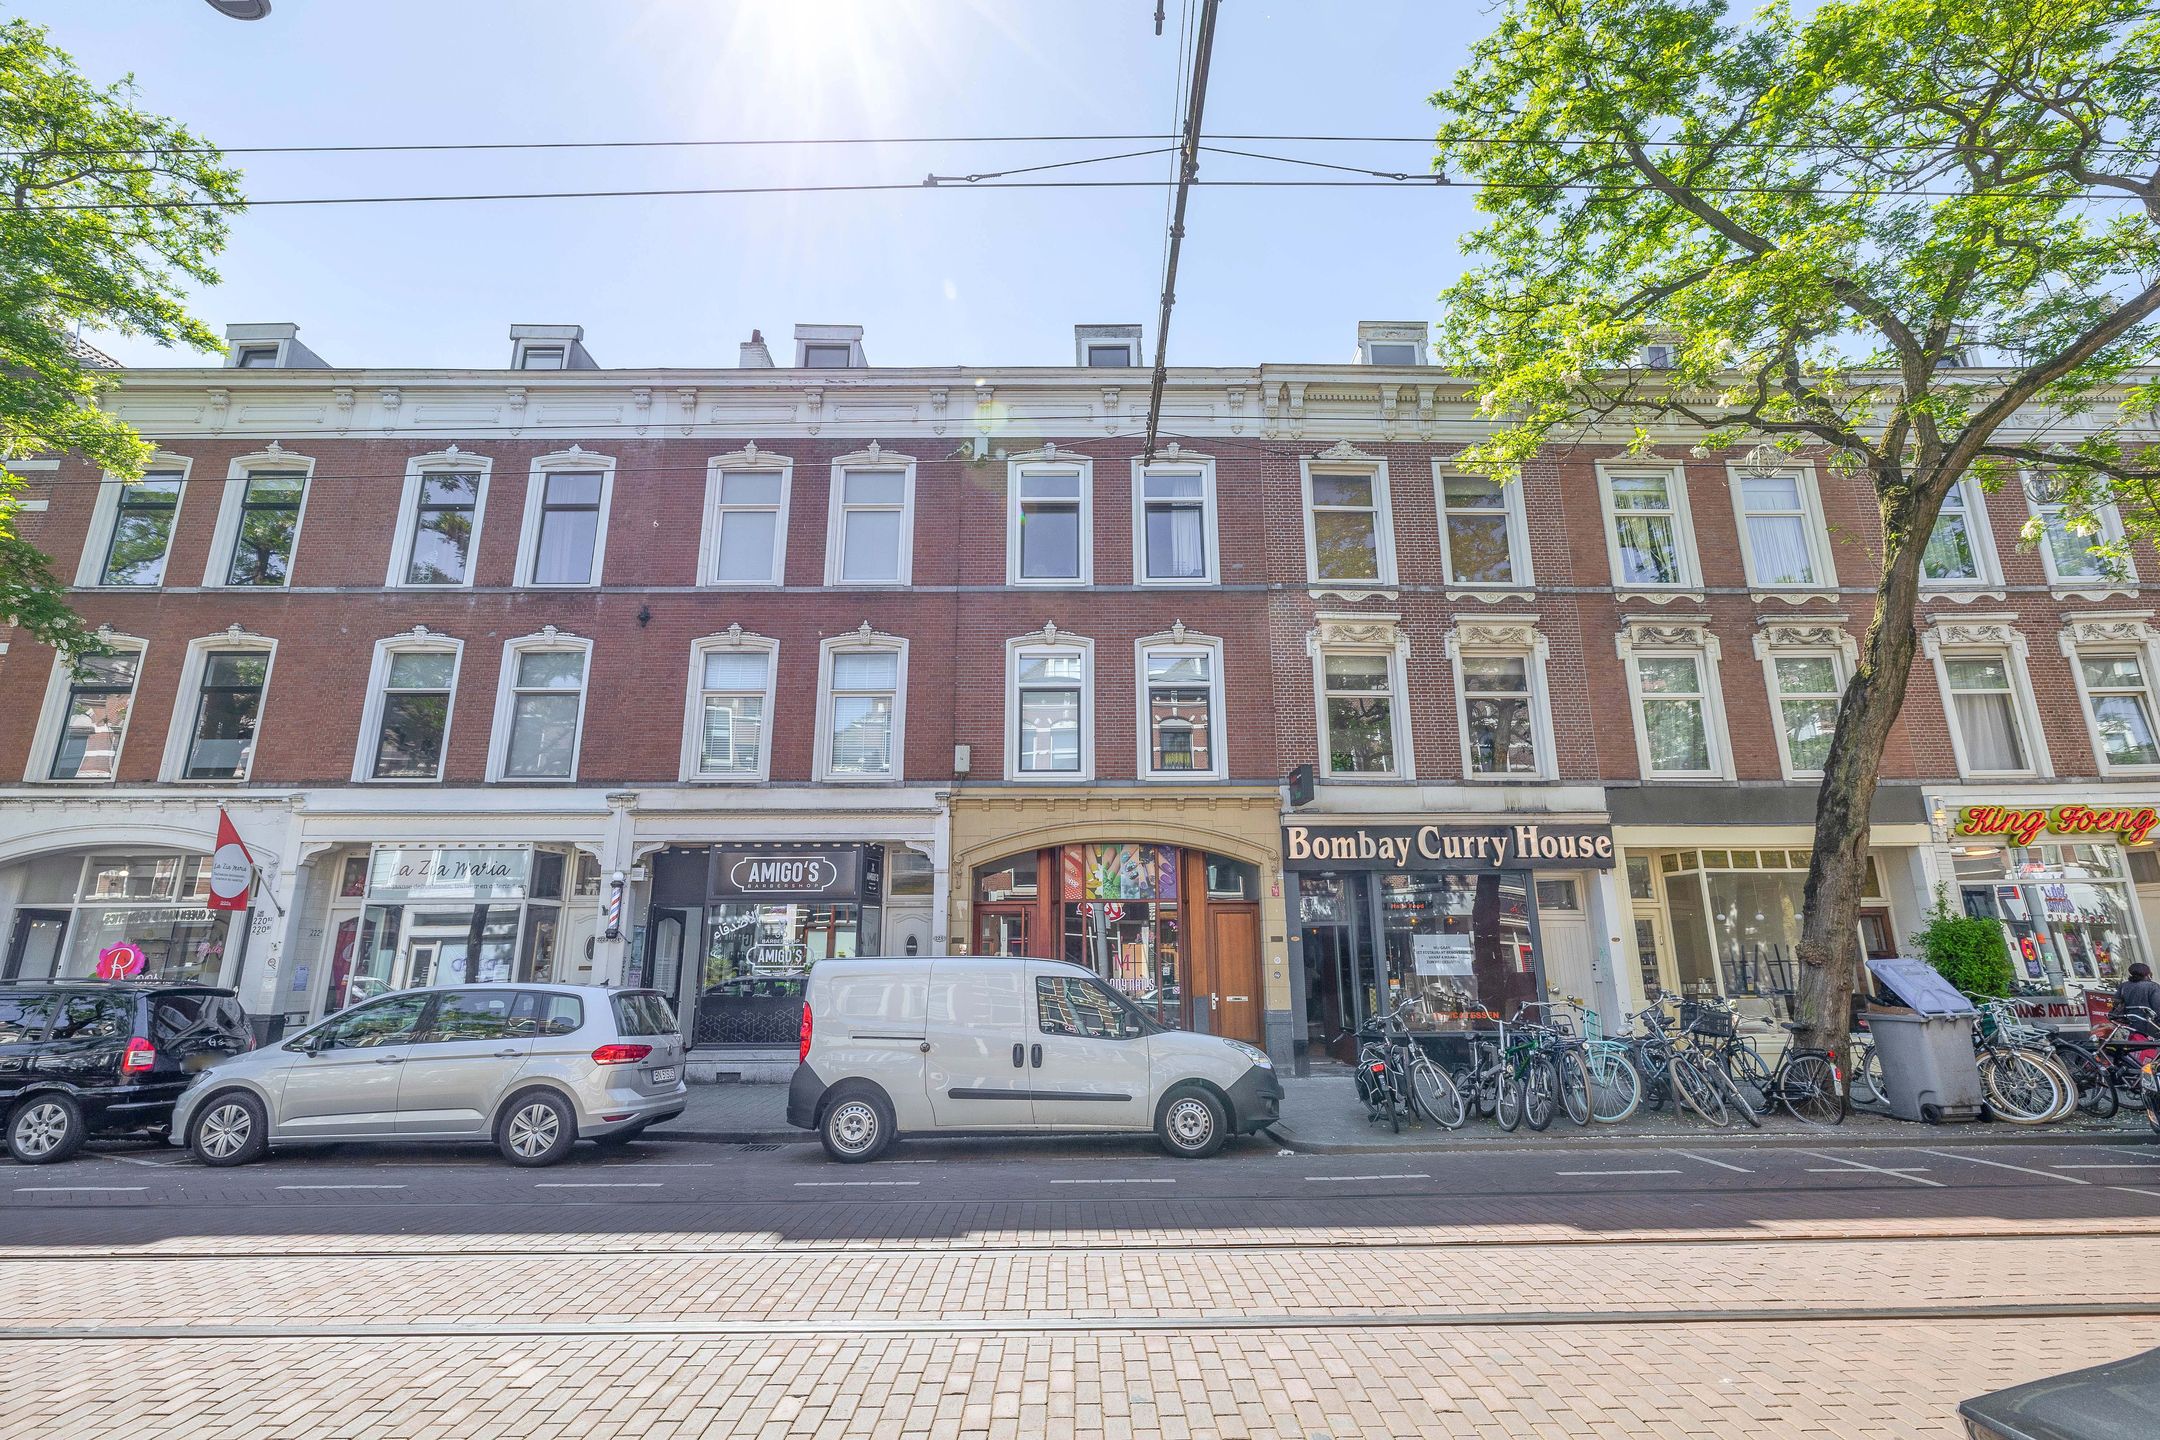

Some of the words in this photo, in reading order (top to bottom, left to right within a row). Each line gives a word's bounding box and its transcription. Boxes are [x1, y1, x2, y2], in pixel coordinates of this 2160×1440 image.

[1964, 807, 2047, 845] King
[2057, 806, 2160, 843] Foeng
[1287, 826, 1412, 867] Bombay
[1417, 825, 1507, 867] Curry
[1513, 824, 1612, 858] House
[418, 859, 450, 877] Za
[453, 859, 511, 879] Maria
[748, 861, 820, 883] AMIGO'S
[757, 949, 803, 963] AMIGO'S
